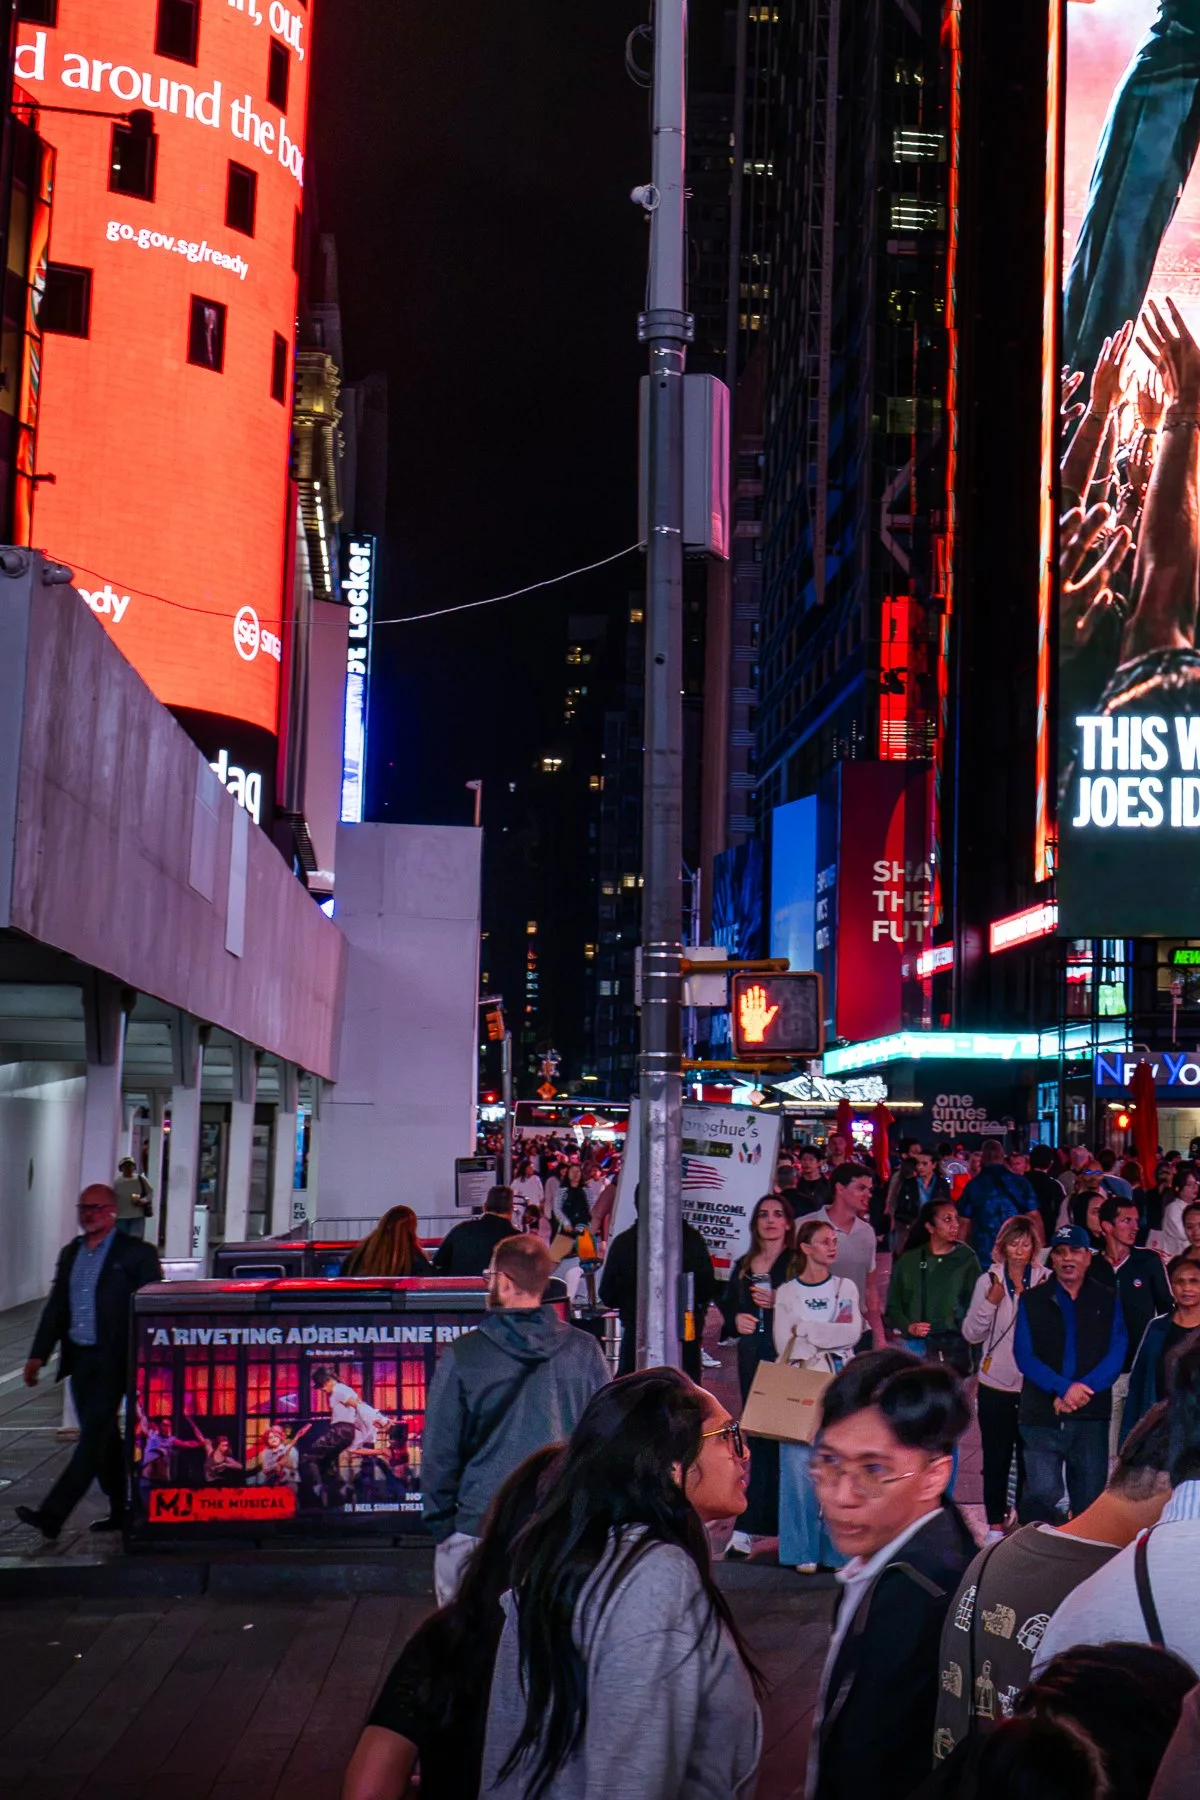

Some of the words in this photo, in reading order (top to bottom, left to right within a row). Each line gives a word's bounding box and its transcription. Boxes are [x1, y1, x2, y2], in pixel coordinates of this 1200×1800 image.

[268, 0, 306, 62] out,
[60, 52, 223, 129] around
[229, 93, 274, 156] the
[105, 220, 250, 281] go.gov.sg/ready
[1076, 716, 1169, 771] THIS
[1072, 776, 1164, 828] JOES
[872, 890, 930, 912] THE
[931, 1106, 988, 1120] times
[935, 1094, 974, 1107] one
[171, 1327, 283, 1346] RIVETING
[284, 1325, 433, 1345] ADRENALINE
[200, 1498, 225, 1510] THE
[229, 1497, 286, 1510] MUSICAL
